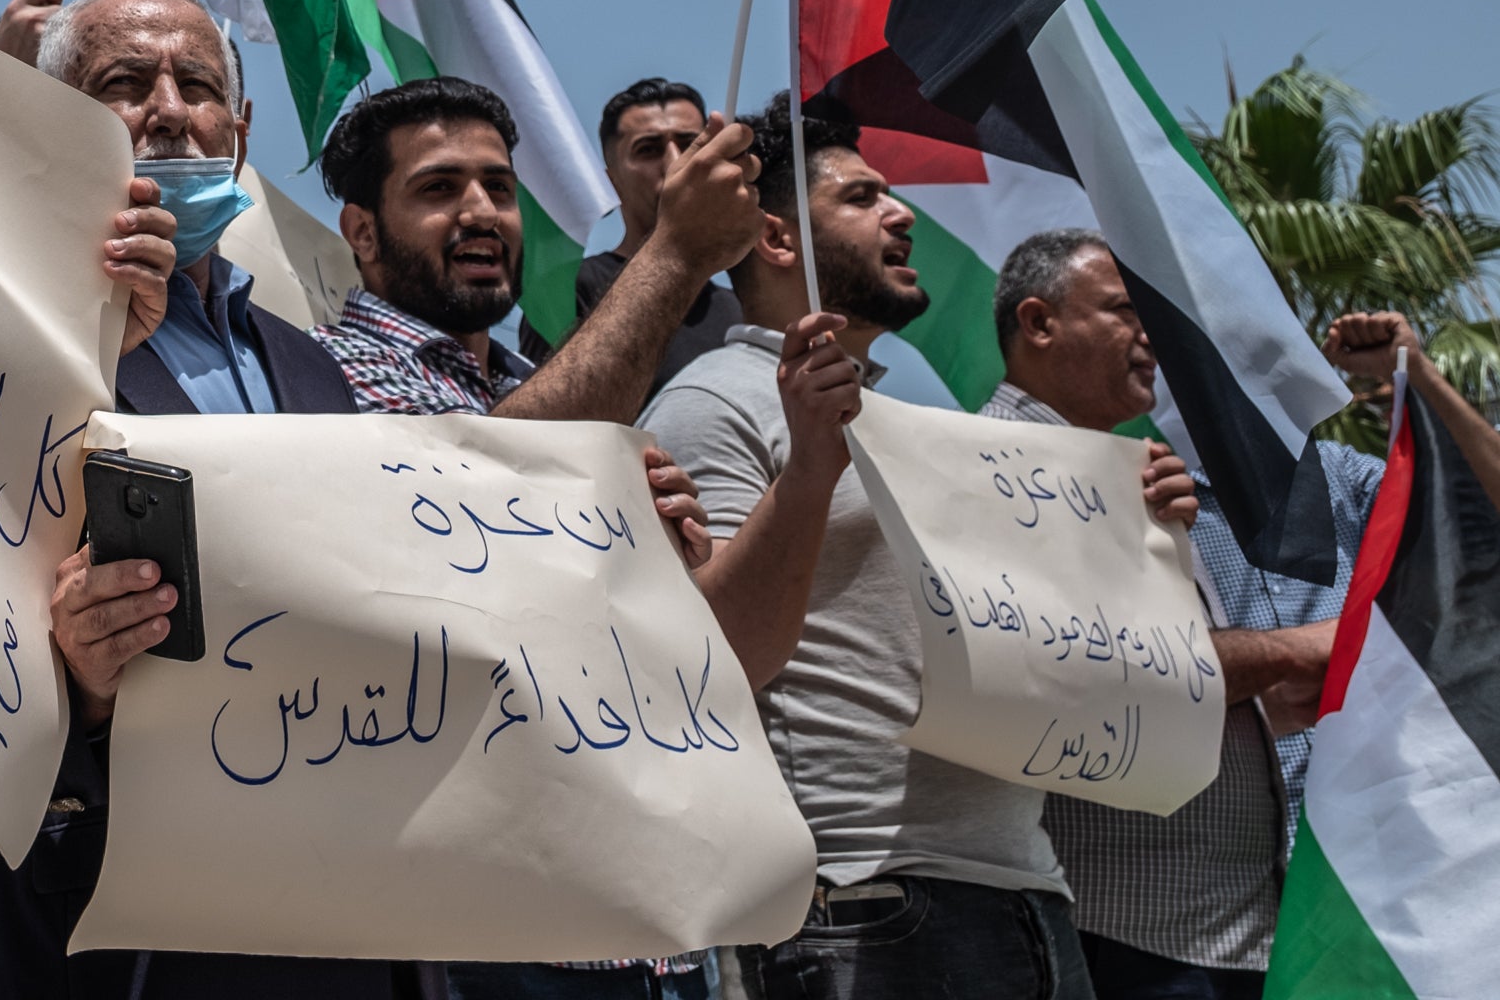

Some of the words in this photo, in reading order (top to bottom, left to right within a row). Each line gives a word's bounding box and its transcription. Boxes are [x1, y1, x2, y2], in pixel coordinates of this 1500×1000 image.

[380, 462, 554, 574] غزة
[554, 500, 636, 551] من
[978, 447, 1058, 529] غزة
[1057, 474, 1108, 523] من
[919, 560, 957, 636] في
[1115, 624, 1180, 683] الدعم
[1174, 619, 1217, 703] كل
[211, 610, 449, 786] للقدس
[1021, 703, 1141, 782] القدس
